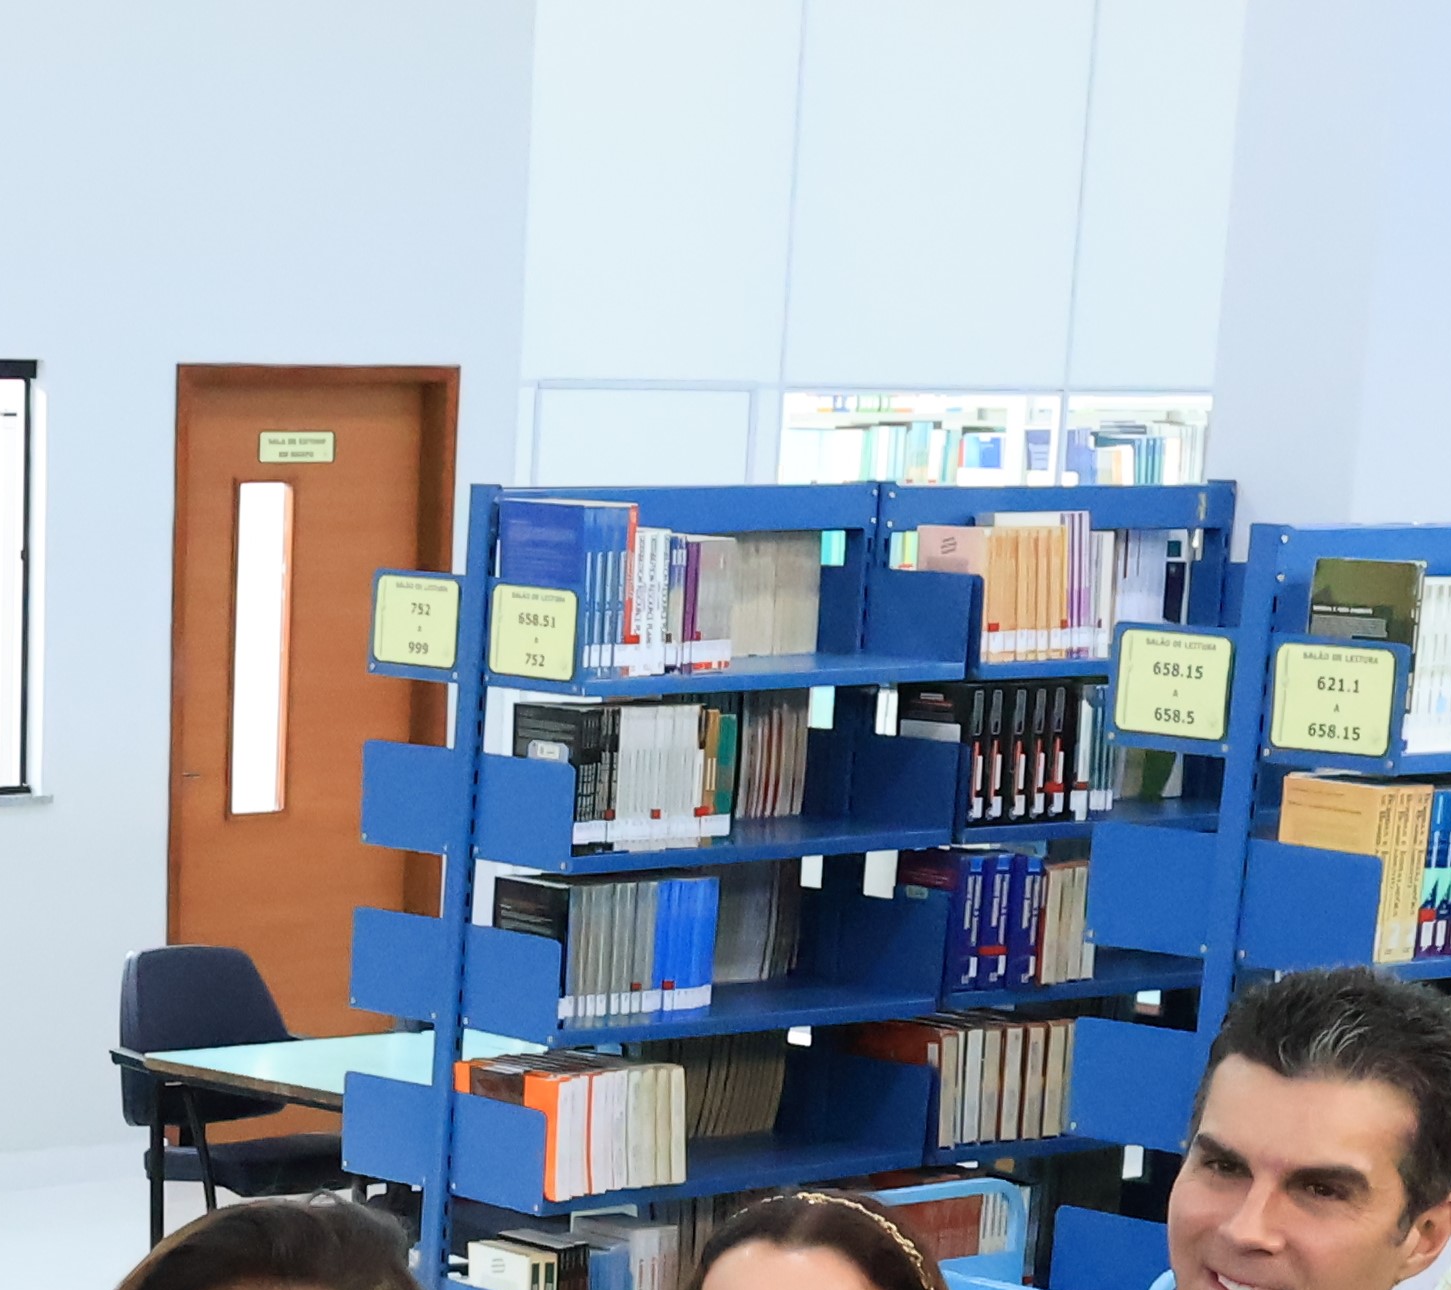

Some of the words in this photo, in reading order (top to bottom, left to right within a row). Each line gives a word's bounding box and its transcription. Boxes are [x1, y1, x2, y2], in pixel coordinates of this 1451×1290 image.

[411, 602, 431, 616] 752
[518, 612, 556, 628] 658.51
[408, 641, 429, 654] 999
[525, 653, 545, 667] 752
[1332, 654, 1342, 662] DE
[1153, 661, 1204, 680] 658.15
[1317, 676, 1360, 693] 621.1
[1154, 707, 1195, 724] 658.5
[1333, 704, 1340, 713] A
[1308, 723, 1361, 741] 658.15
